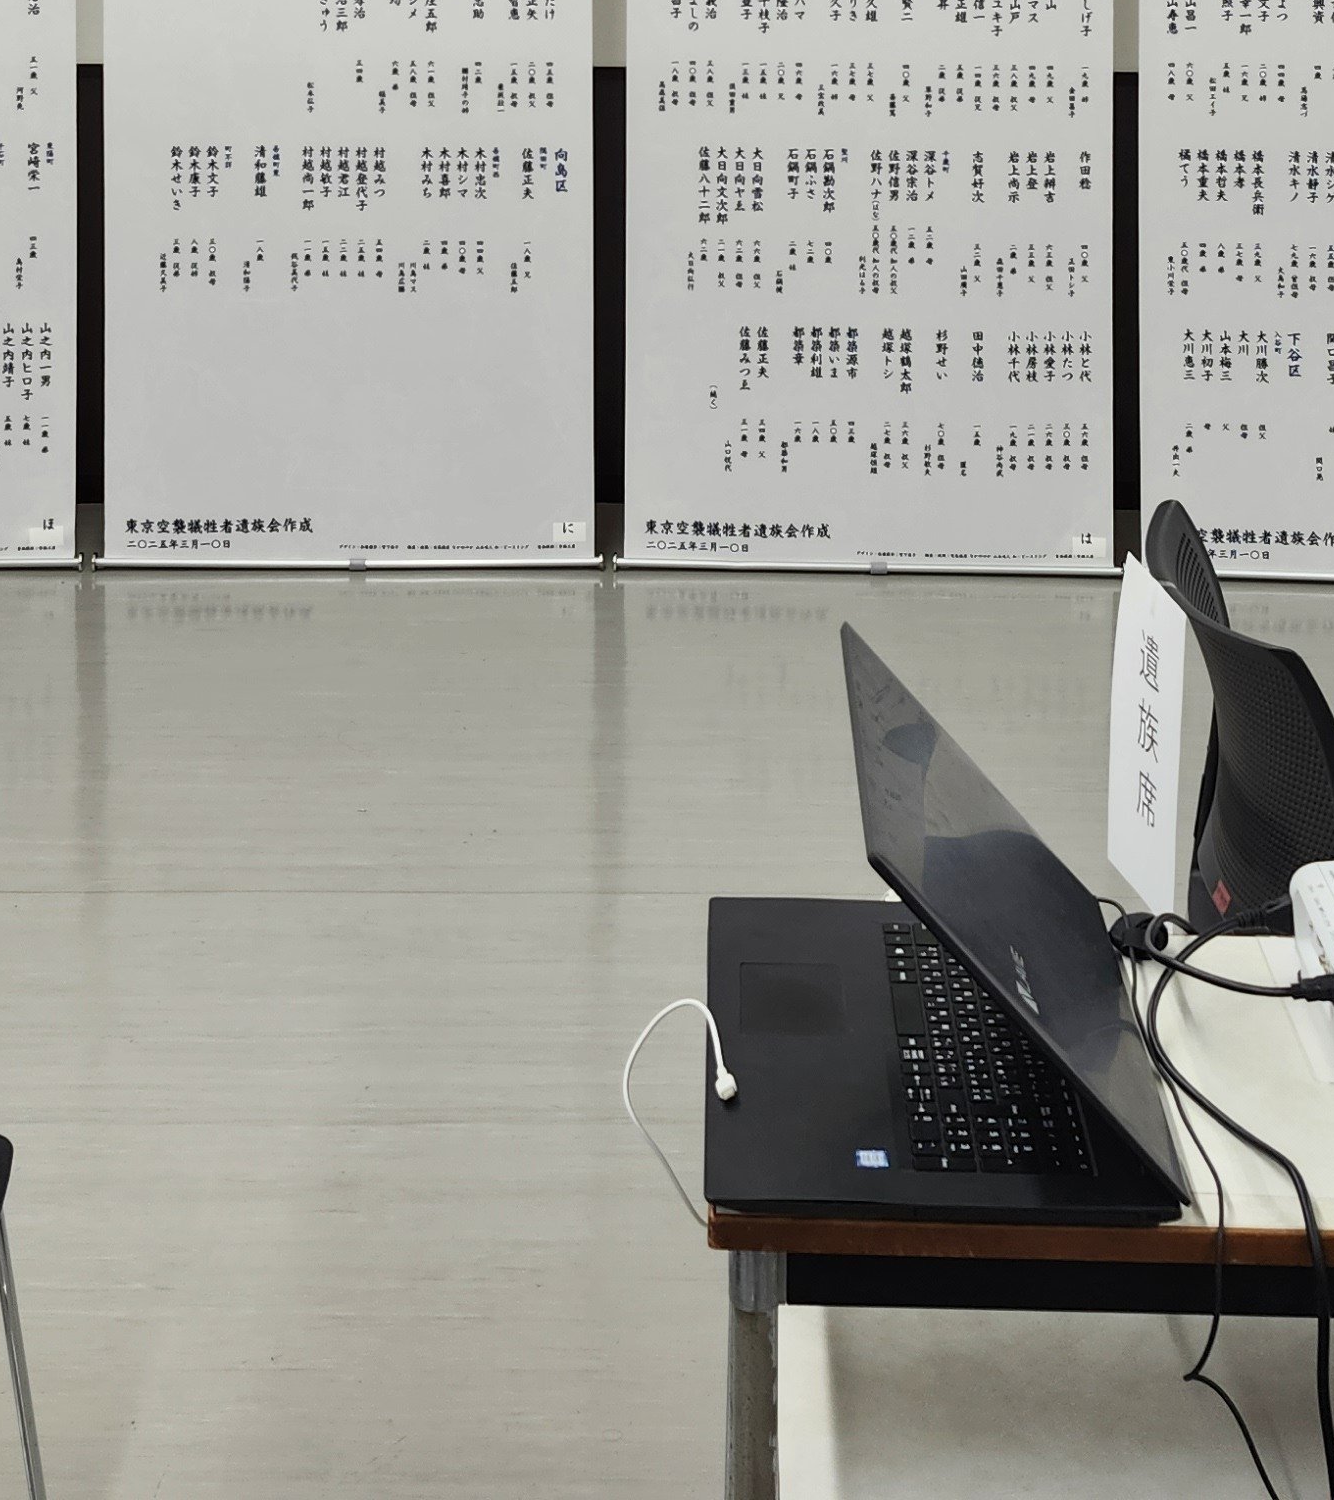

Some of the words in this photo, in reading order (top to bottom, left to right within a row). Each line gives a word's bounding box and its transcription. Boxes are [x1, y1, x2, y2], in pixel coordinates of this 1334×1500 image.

[205, 145, 220, 198] 鈴木文子
[373, 146, 387, 198] 村越みつ
[456, 146, 470, 198] 木村シマ
[474, 146, 488, 200] 木村忠次
[554, 147, 569, 193] 向島区
[715, 145, 729, 226] 大日向文次郎
[887, 149, 901, 202] 佐野信男
[20, 322, 35, 401] 山之内ヒロ子
[38, 322, 54, 388] 山之内一男
[1200, 328, 1214, 382] 大川初子
[1286, 332, 1304, 378] 下谷区
[125, 517, 314, 535] 東京空襲犠牲者遺族会作成
[645, 519, 831, 539] 東京空襲犠牲者遺族会作成
[1207, 548, 1271, 561] 年三月一〇日
[1135, 628, 1161, 829] 遺族席
